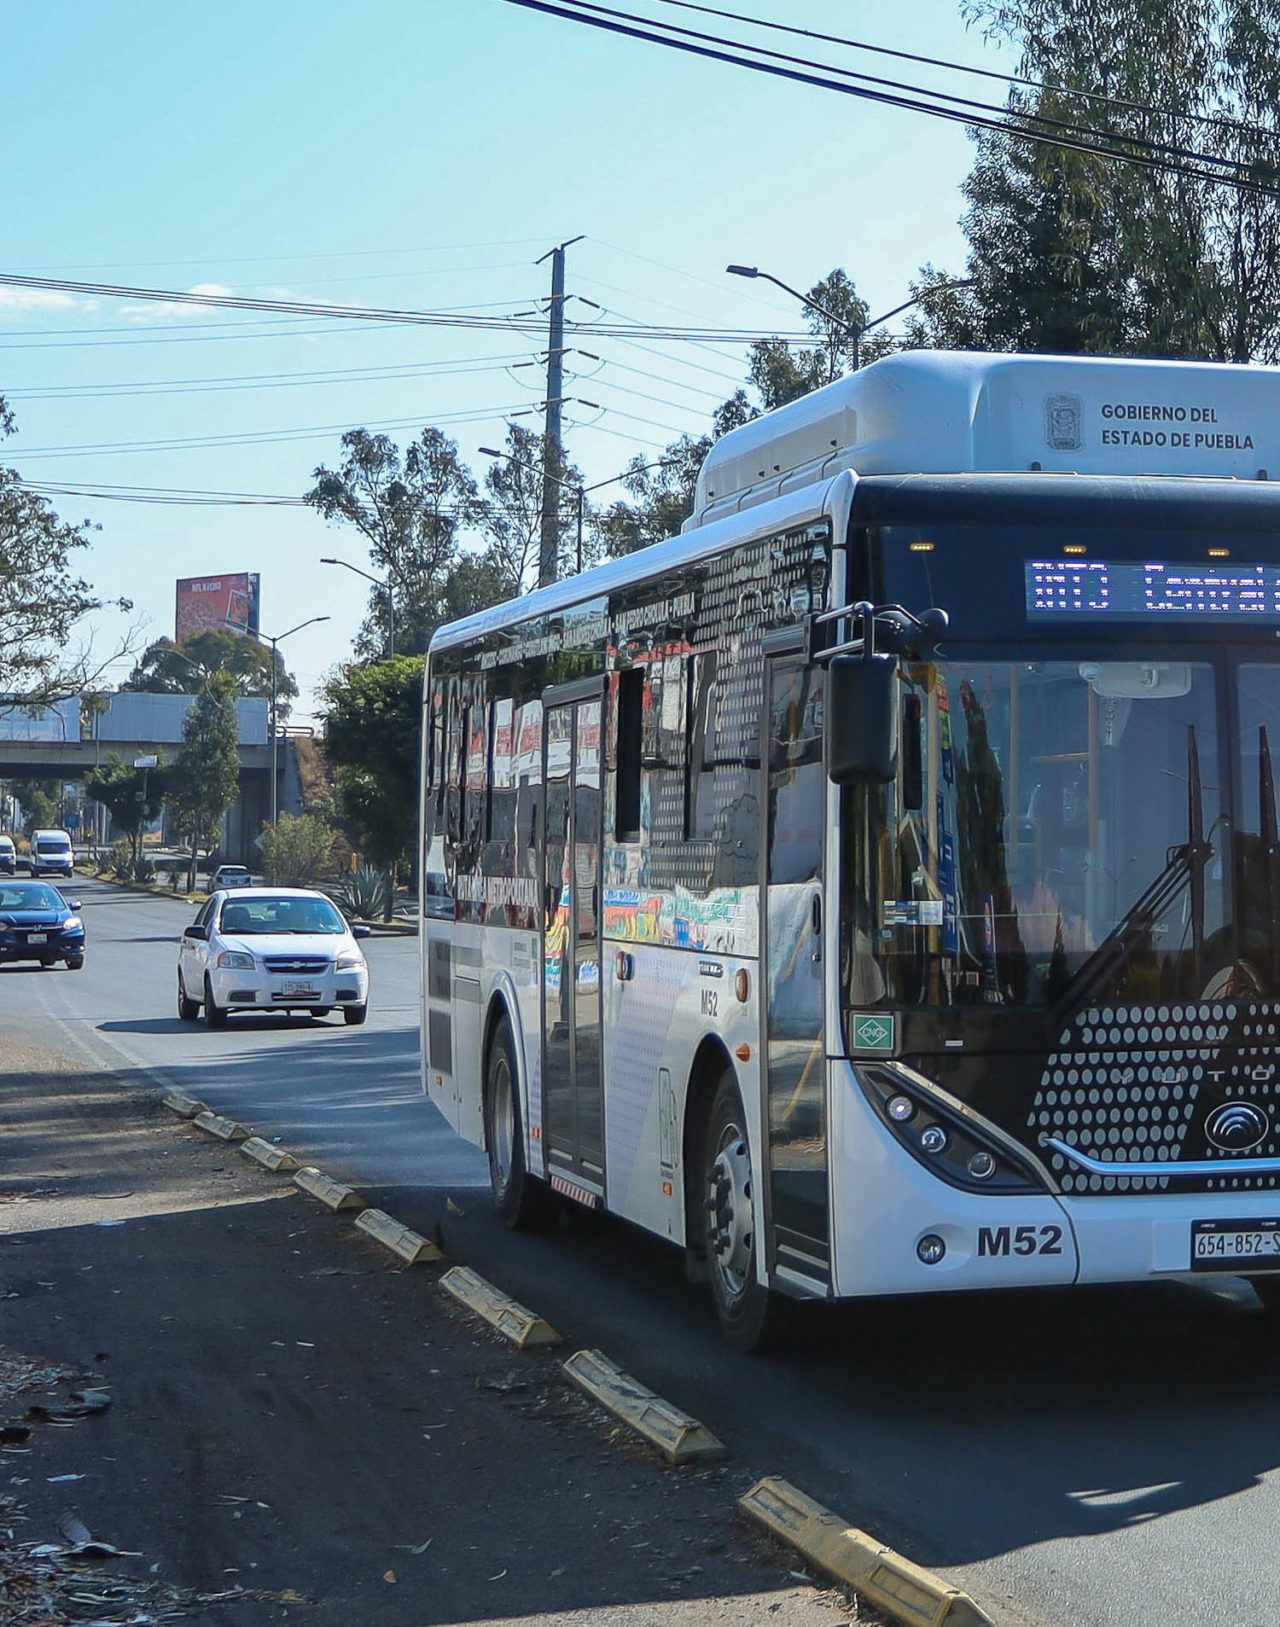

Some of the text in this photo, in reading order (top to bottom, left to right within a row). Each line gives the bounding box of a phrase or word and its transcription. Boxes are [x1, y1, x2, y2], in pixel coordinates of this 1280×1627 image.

[1101, 403, 1218, 424] GOBIERNO DEL
[1101, 429, 1255, 450] ESTADO DE PUEBLA
[701, 988, 718, 1017] M52
[977, 1224, 1063, 1257] M52
[1197, 1232, 1280, 1256] 654-852-S
